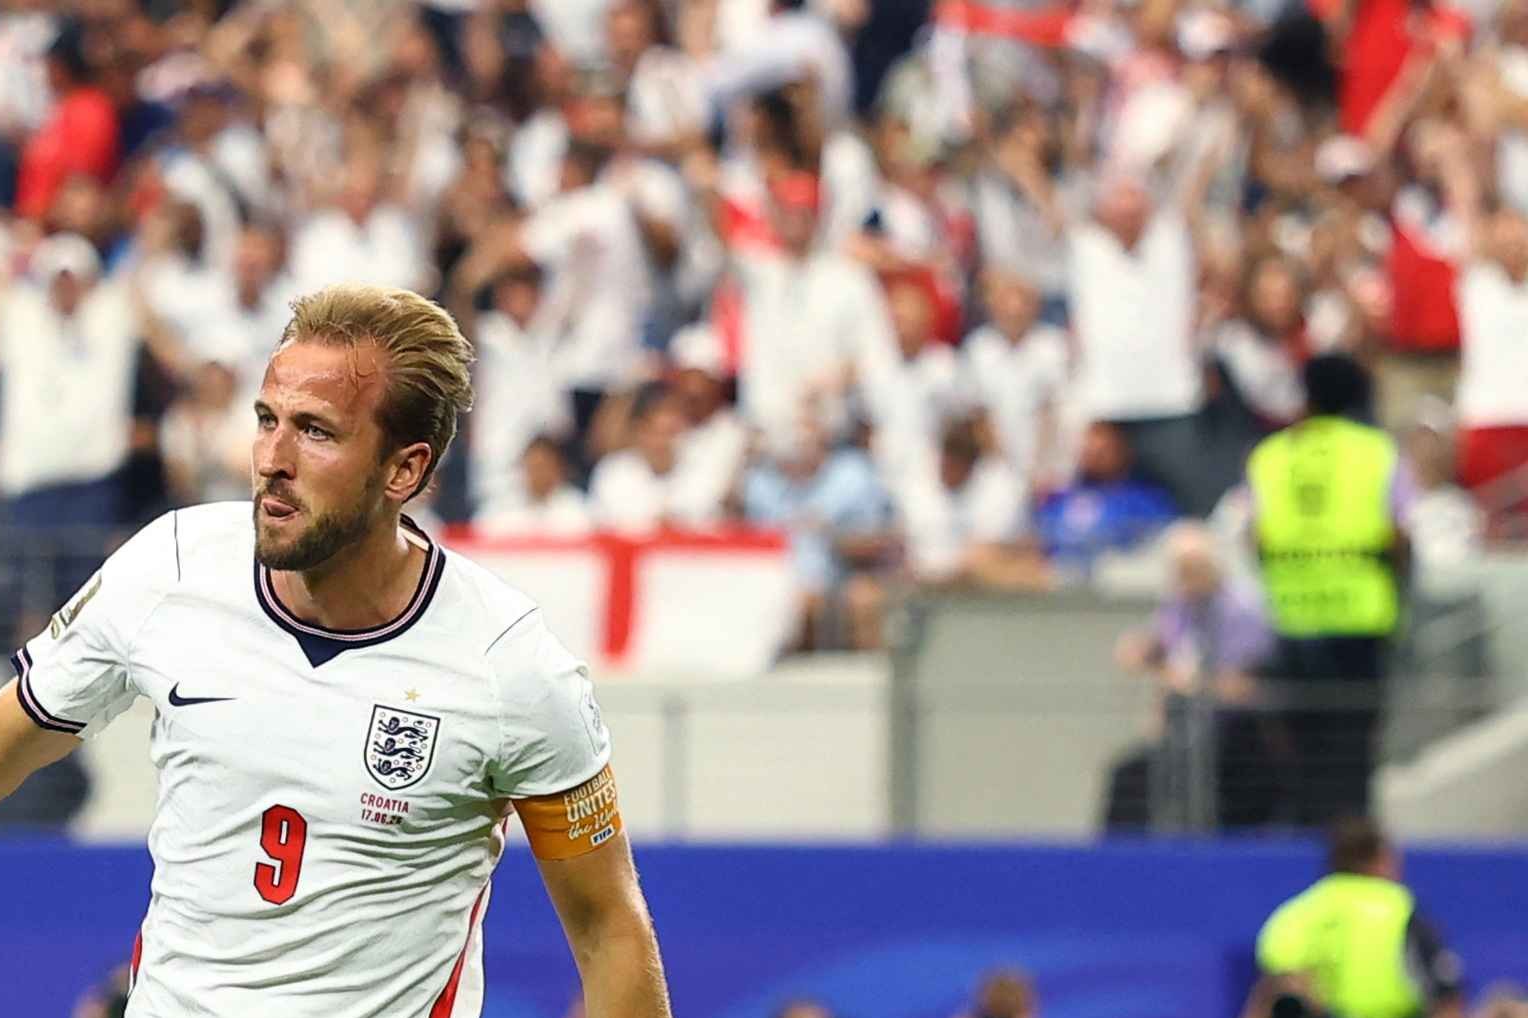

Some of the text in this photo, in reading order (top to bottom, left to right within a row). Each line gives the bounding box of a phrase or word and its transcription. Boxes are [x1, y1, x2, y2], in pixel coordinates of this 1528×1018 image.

[360, 792, 410, 813] CROATIA
[592, 827, 613, 844] FIFA
[253, 803, 308, 906] 9
